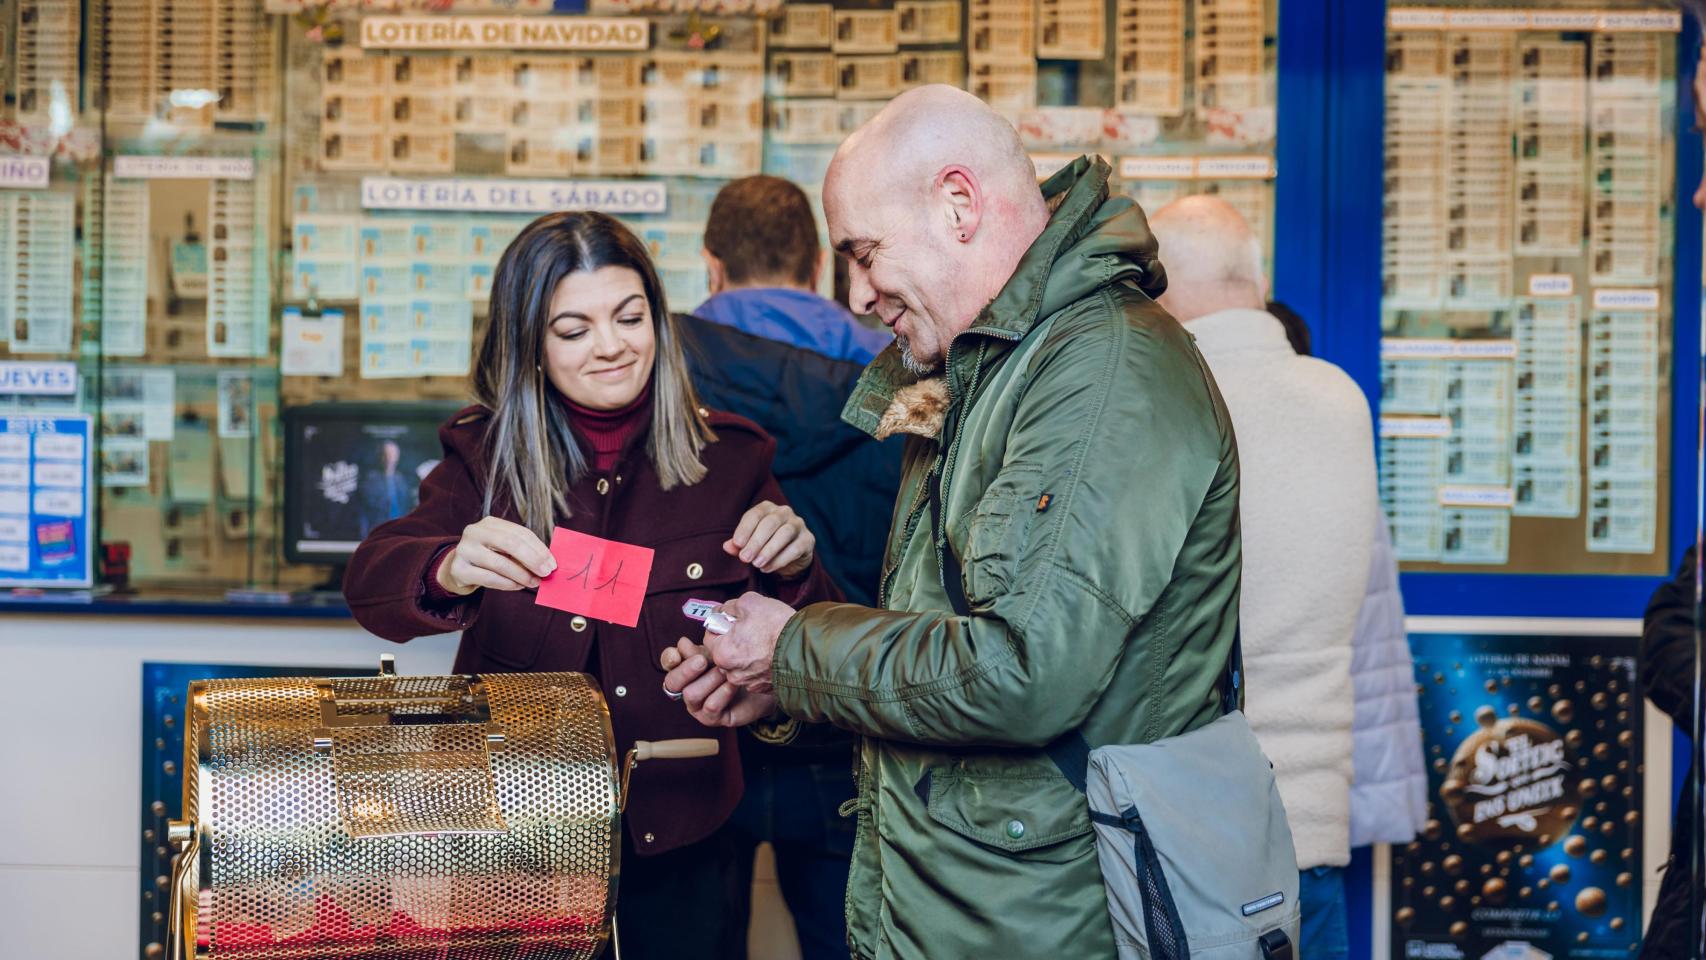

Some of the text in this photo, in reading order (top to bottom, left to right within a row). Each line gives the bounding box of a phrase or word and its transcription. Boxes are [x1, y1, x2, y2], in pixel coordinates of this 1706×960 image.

[366, 17, 644, 45] LOTERÍA DE NAVIDAD
[367, 179, 660, 207] LOTERÍA DEL SÁBADO
[566, 553, 623, 595] 11
[691, 608, 707, 617] 11
